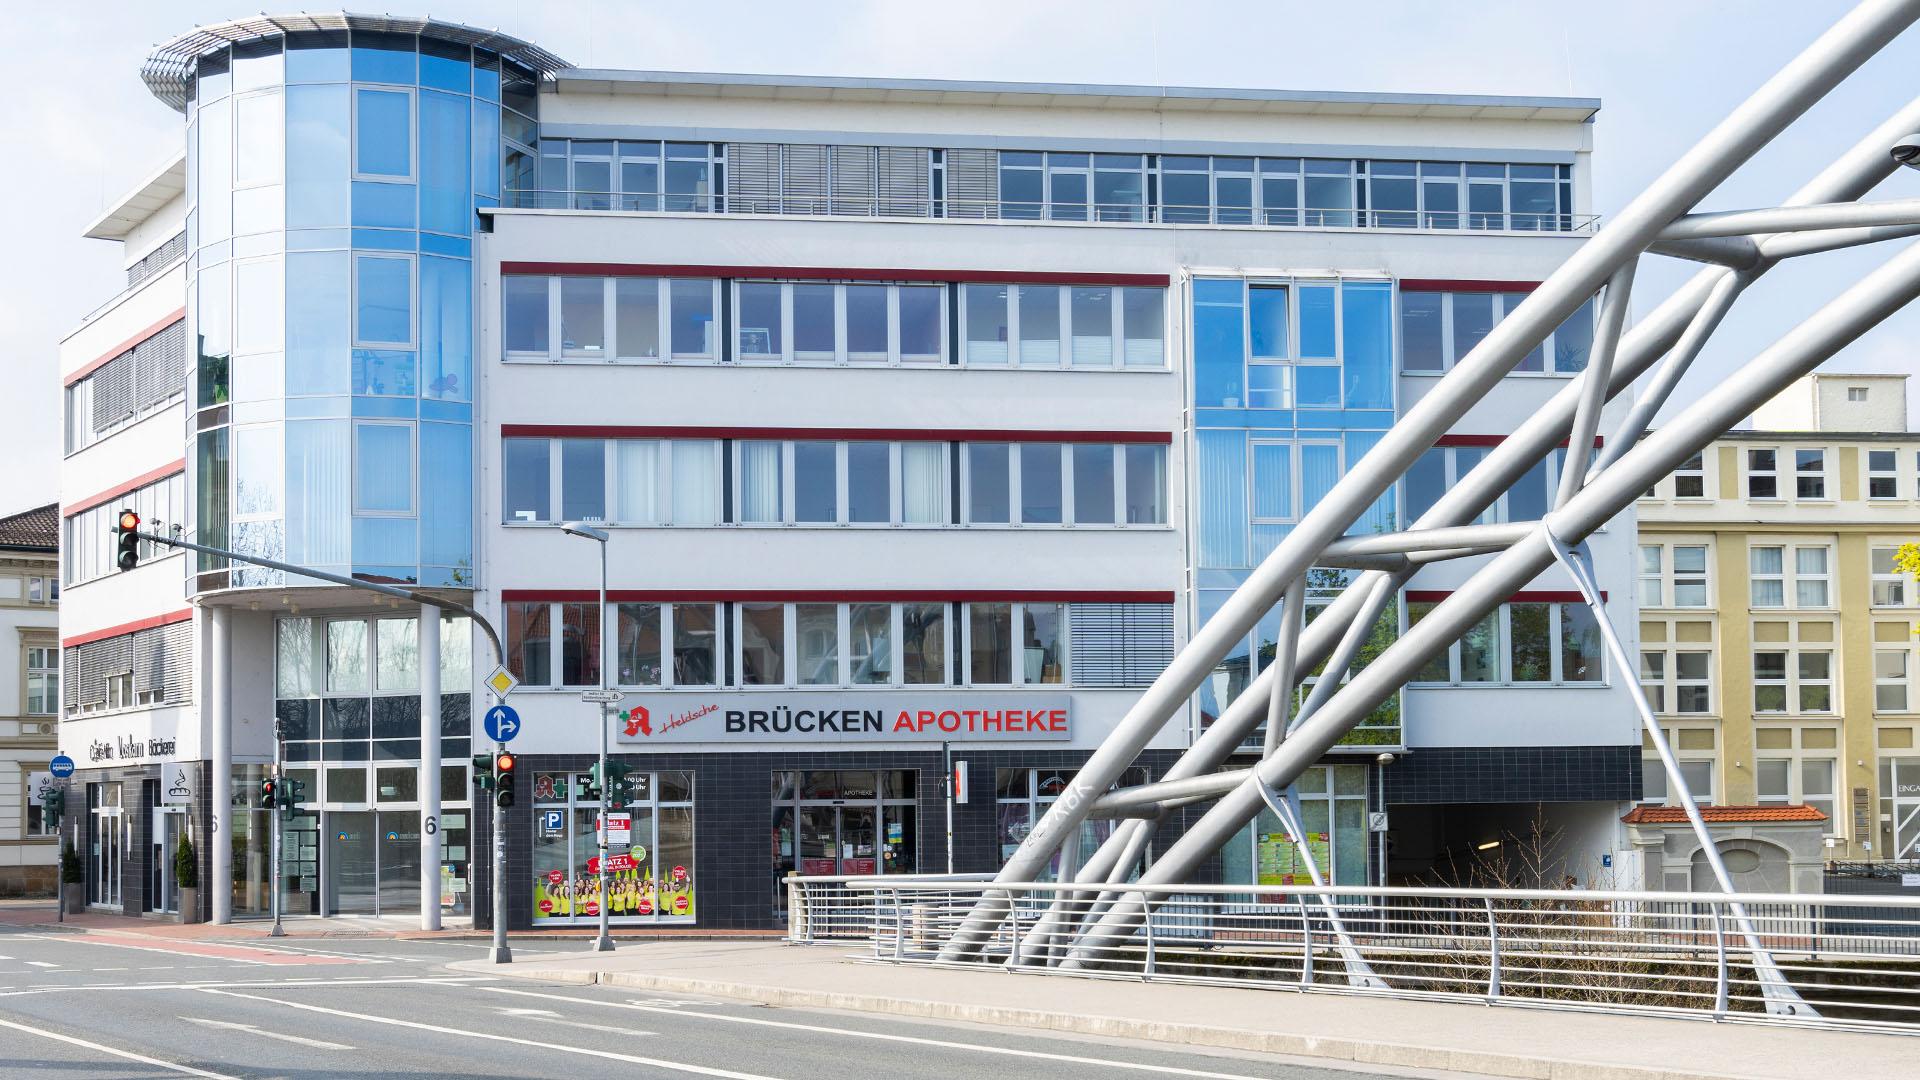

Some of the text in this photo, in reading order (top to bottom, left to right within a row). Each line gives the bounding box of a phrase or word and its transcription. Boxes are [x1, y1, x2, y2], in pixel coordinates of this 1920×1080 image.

[725, 705, 883, 733] BRÜCKEN
[893, 710, 1068, 732] APOTHEKE
[424, 815, 438, 836] 6
[548, 813, 559, 827] P
